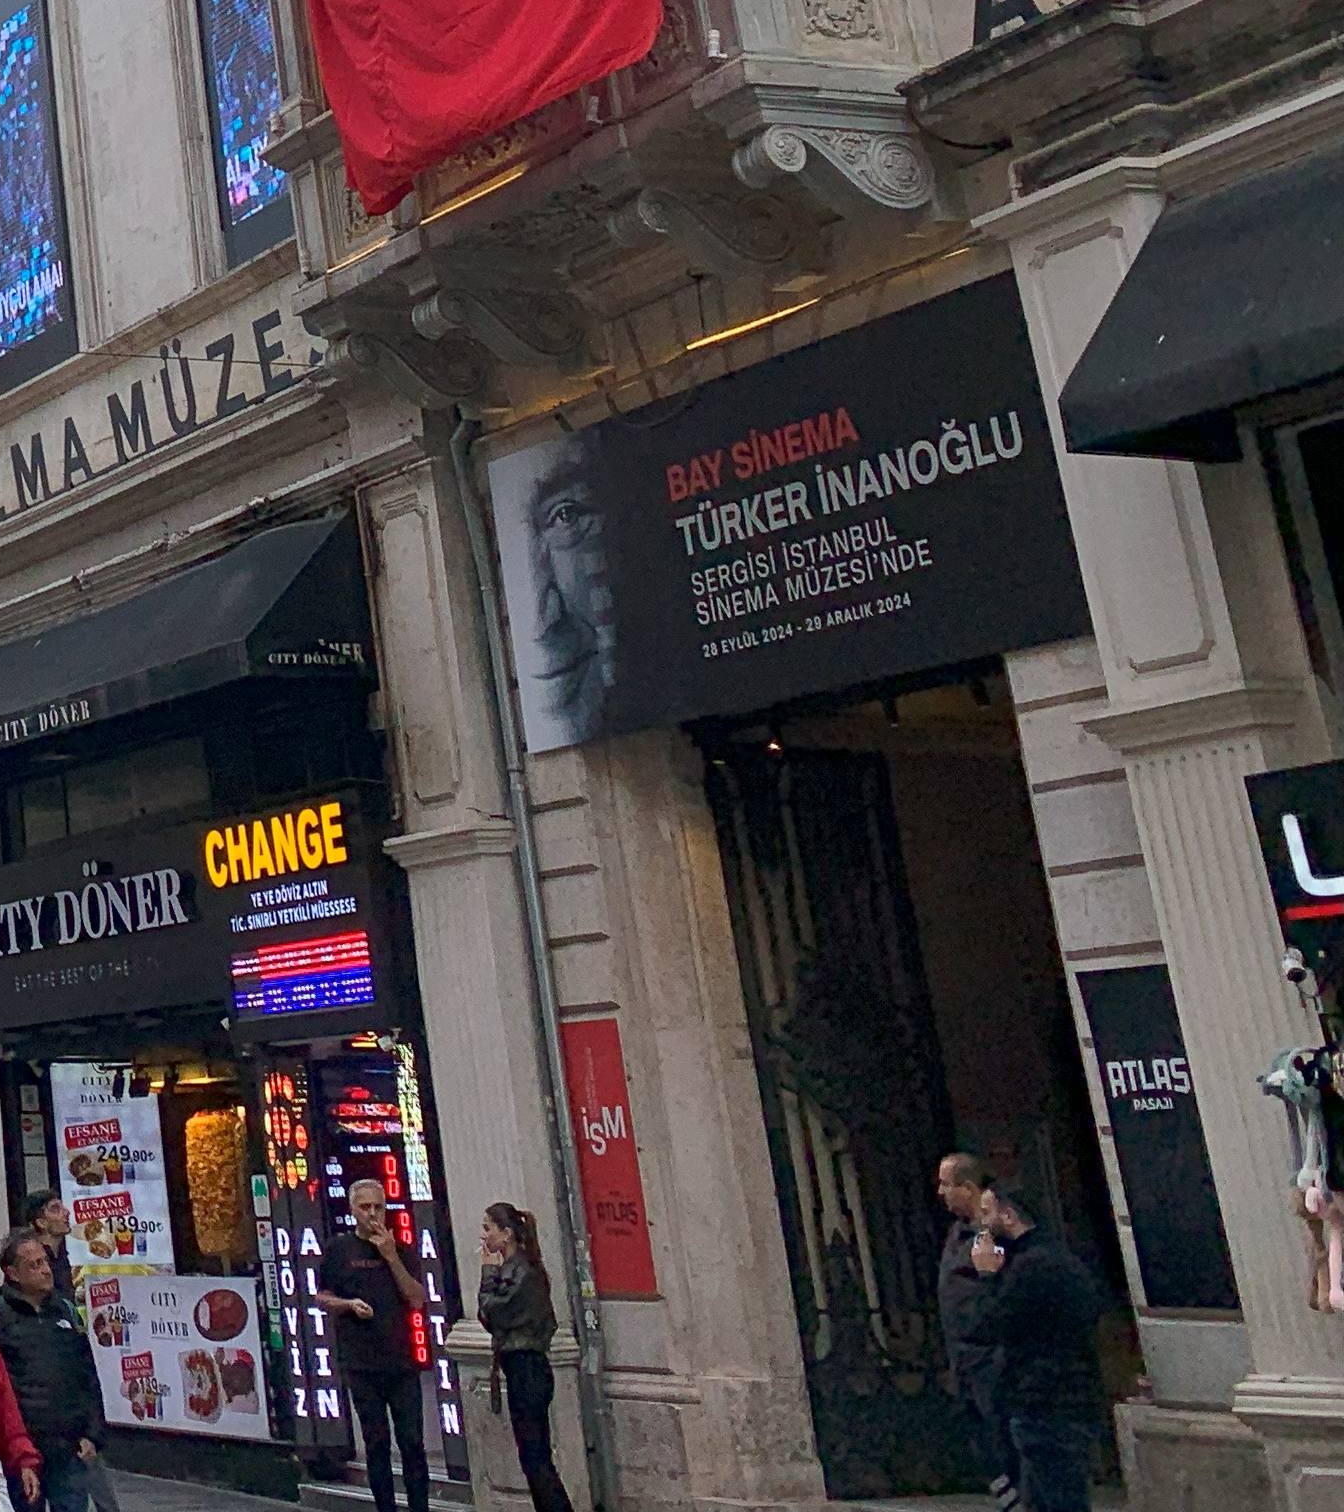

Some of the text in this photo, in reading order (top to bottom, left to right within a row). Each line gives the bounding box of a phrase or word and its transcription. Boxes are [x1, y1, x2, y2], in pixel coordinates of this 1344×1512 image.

[666, 406, 860, 503] BAY SİNEMA
[675, 411, 1023, 556] TÜRKER İNANOĞLU
[691, 516, 897, 597] SERGİSİ İSTANBUL
[695, 583, 780, 626] SİNEMA
[702, 642, 718, 658] 28
[721, 630, 759, 654] EYLÜL
[762, 623, 793, 643] 2024
[806, 617, 822, 633] 29
[826, 603, 874, 627] ARALIK
[877, 592, 912, 614] 2024
[38, 700, 91, 733] DÖNER
[205, 802, 347, 888] CHANGE
[54, 859, 190, 946] DÖNER
[251, 880, 328, 908] YE YE DÖVİZ ALTIN
[311, 897, 357, 920] MÜESSESE
[61, 965, 84, 986] BEST
[1106, 1057, 1190, 1099] ATLAS
[1133, 1097, 1174, 1111] PASAJI
[68, 1122, 118, 1139] EFSANE
[326, 1163, 342, 1176] USD
[79, 1196, 125, 1212] EFSANE
[329, 1186, 346, 1198] EUR
[151, 1292, 177, 1307] CITY
[277, 1228, 308, 1418] DÖVİZ
[421, 1229, 460, 1435] ALTIN
